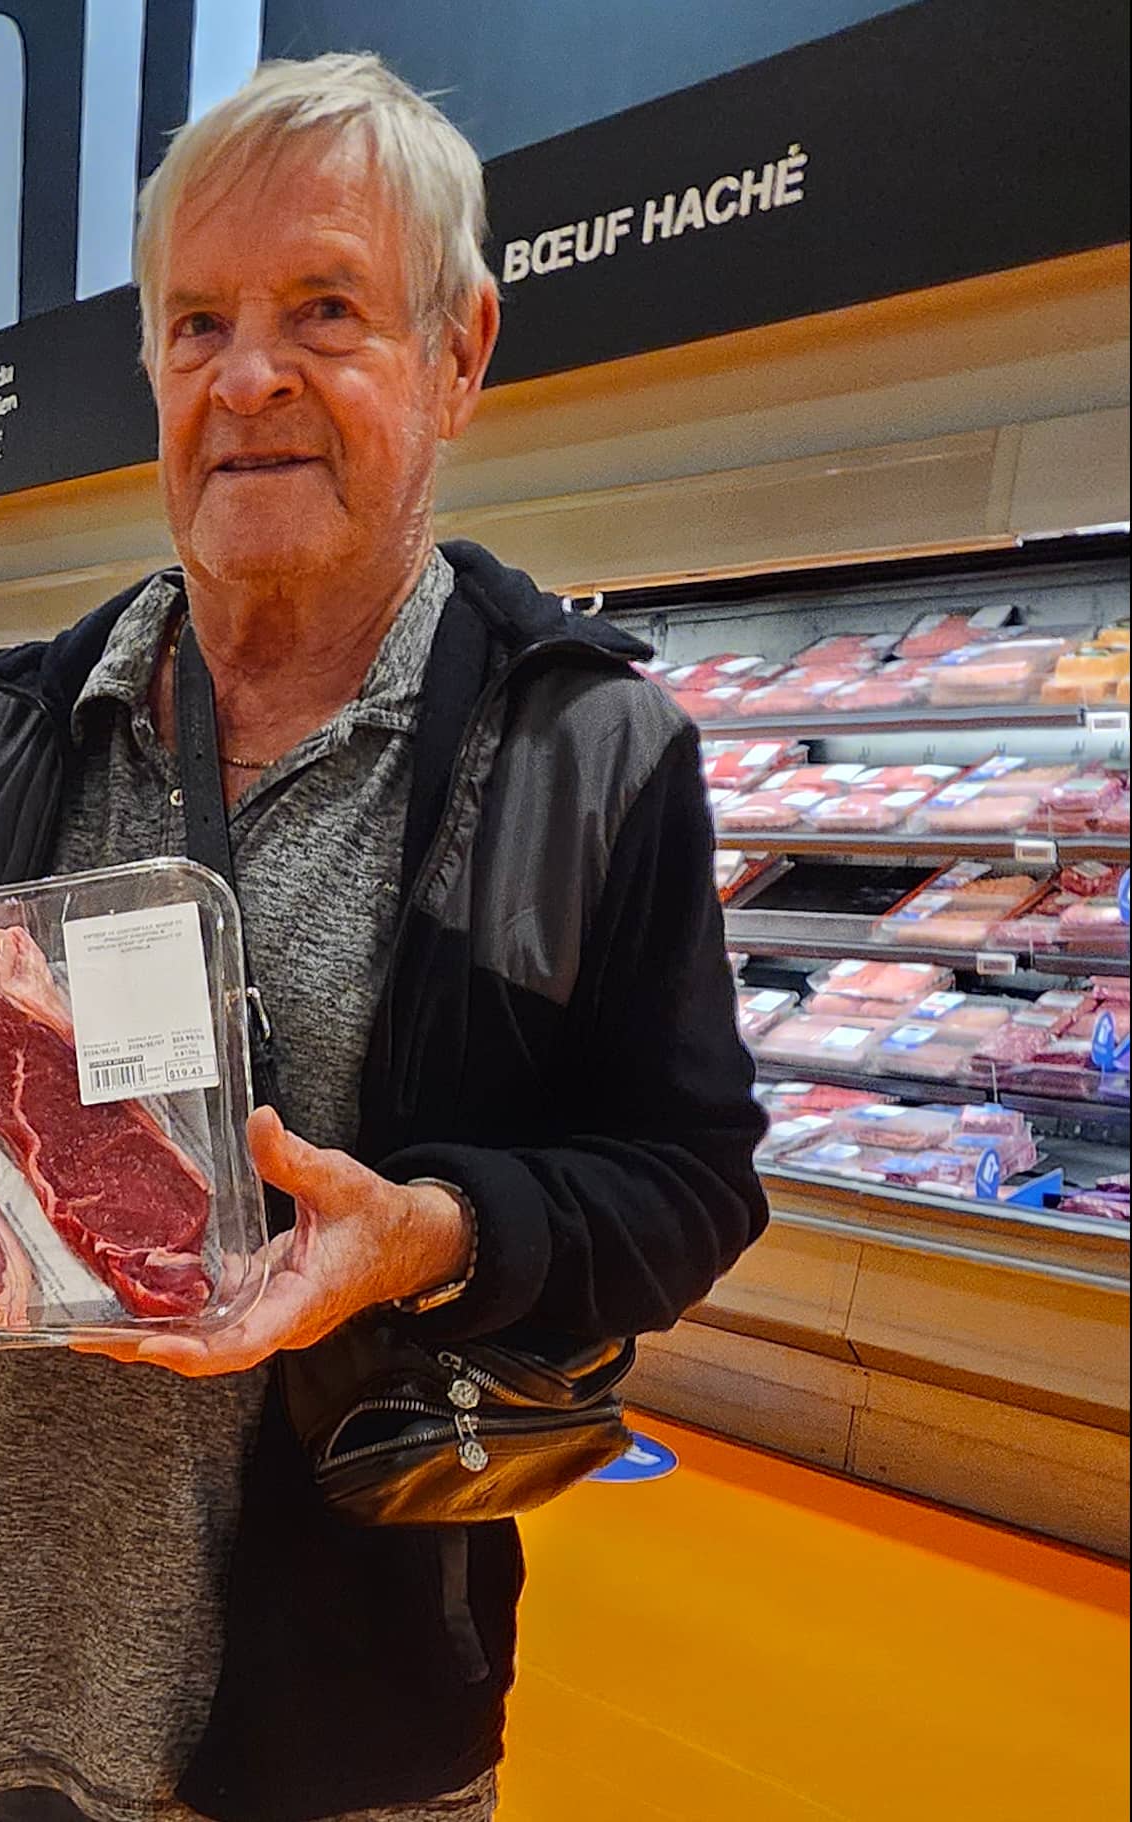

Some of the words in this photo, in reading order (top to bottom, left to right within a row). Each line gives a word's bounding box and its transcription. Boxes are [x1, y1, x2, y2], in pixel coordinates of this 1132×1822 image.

[502, 206, 634, 284] BŒUF
[641, 142, 809, 245] HACHÉ
[169, 1065, 203, 1079] $19.43
